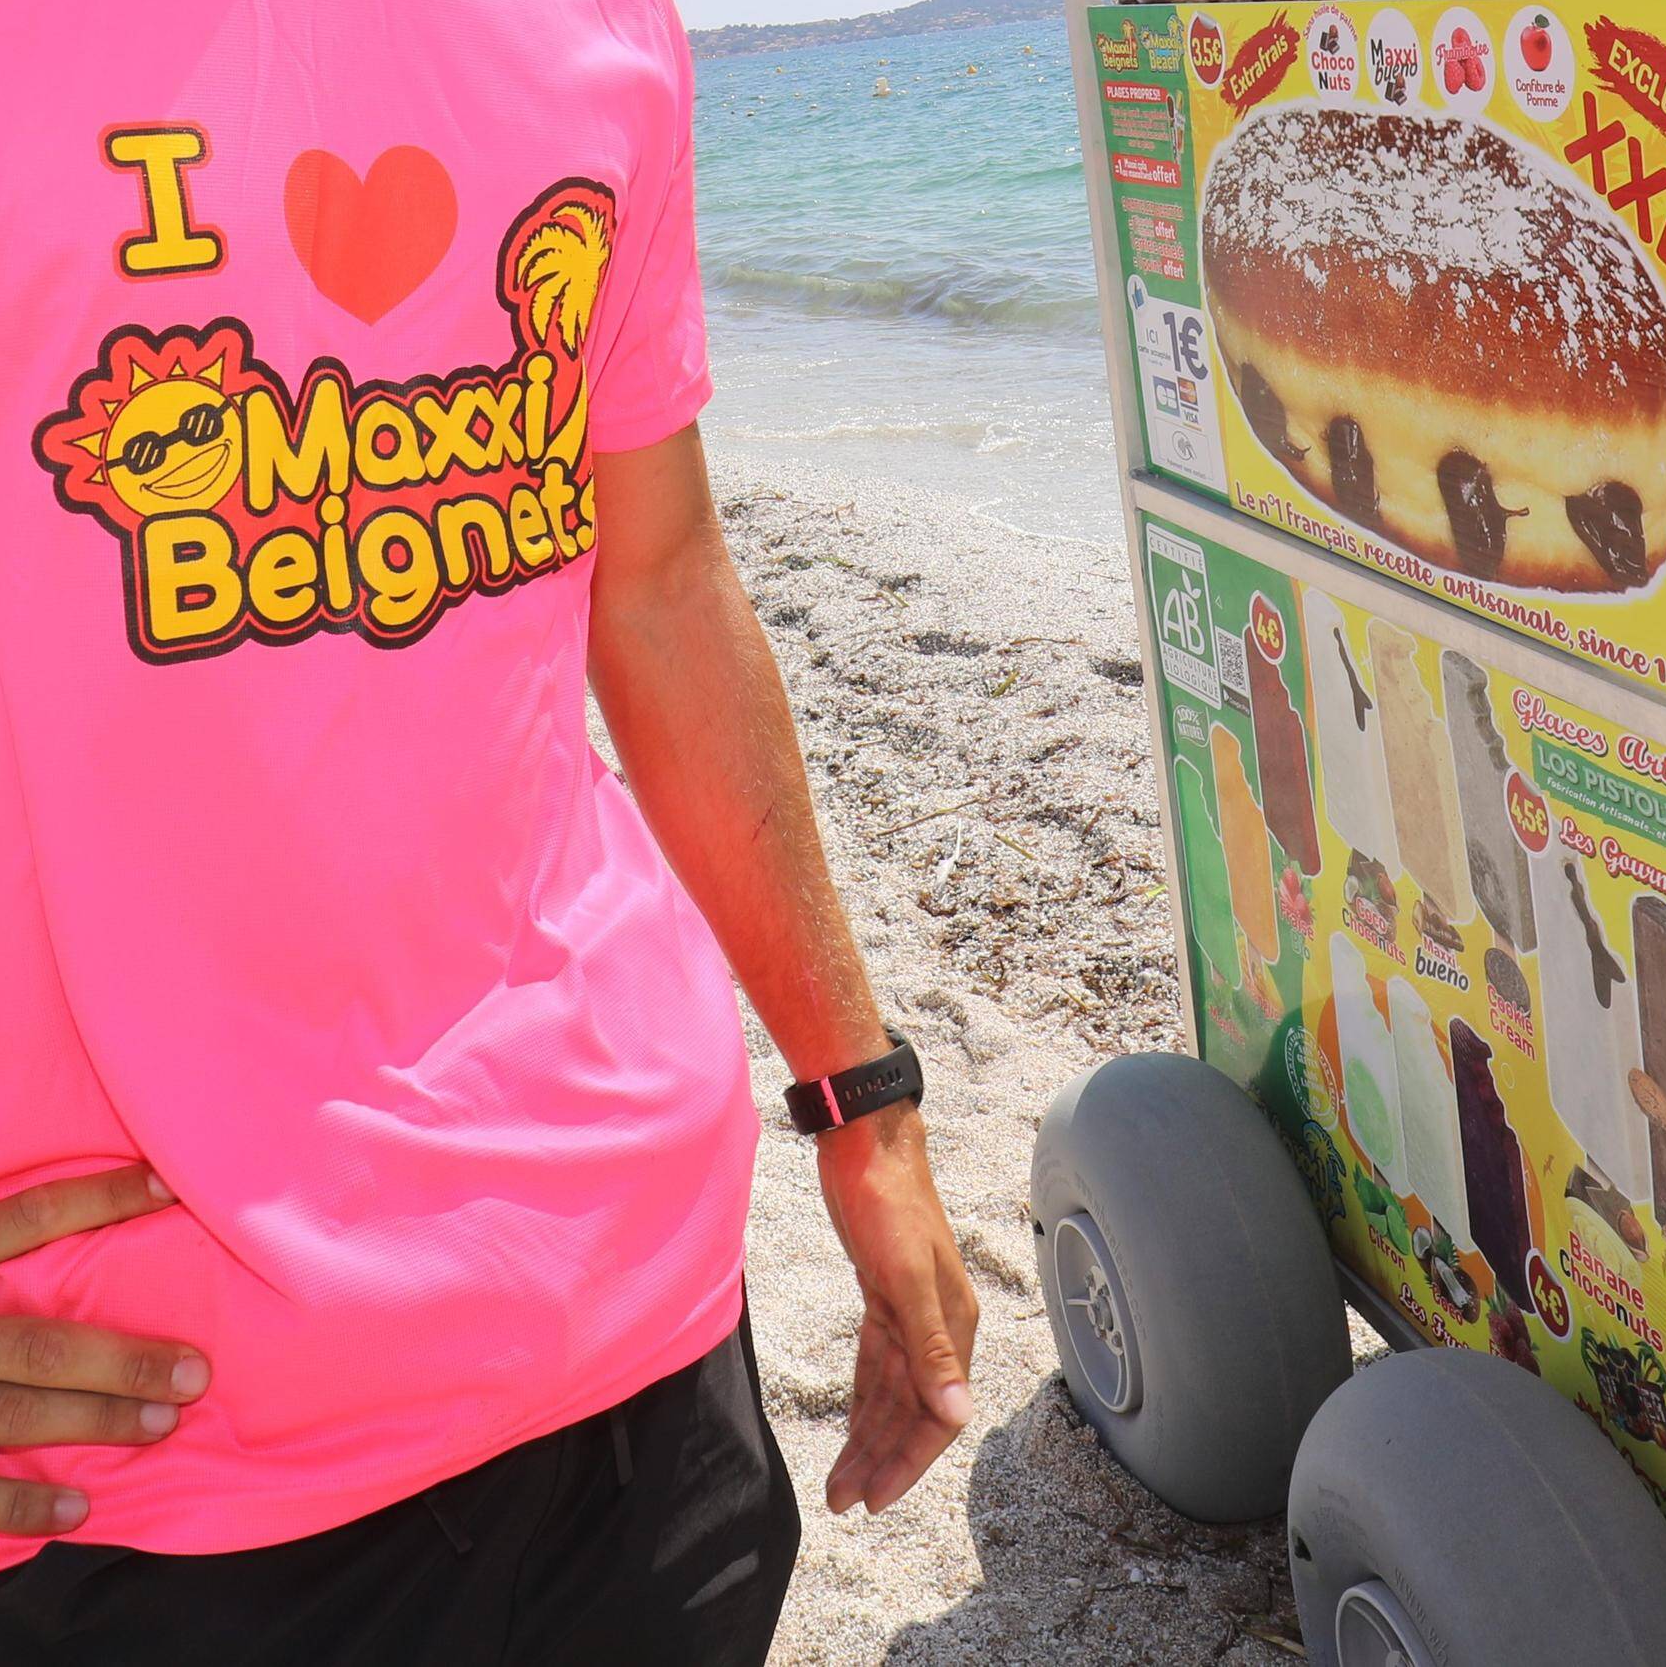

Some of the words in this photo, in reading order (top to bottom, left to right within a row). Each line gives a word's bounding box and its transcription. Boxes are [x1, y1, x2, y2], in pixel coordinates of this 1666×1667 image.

[1192, 38, 1222, 67] 3.5€
[1230, 32, 1289, 101] Extrafrais
[1311, 51, 1355, 70] Choco
[1371, 38, 1418, 66] Maxxi
[1375, 57, 1418, 86] bueno
[1435, 41, 1489, 67] Framboise
[1107, 86, 1130, 100] PLAGES
[1318, 72, 1351, 92] Nuts
[1516, 78, 1554, 94] Confiture
[1555, 80, 1566, 94] de
[1526, 92, 1559, 108] Pomme
[1153, 168, 1177, 184] offert
[106, 129, 223, 275] I
[1155, 221, 1176, 240] offert
[1163, 261, 1184, 279] offert
[1146, 328, 1159, 344] ICI
[1163, 312, 1208, 380] 1€
[245, 352, 555, 512] Maxxi
[1236, 481, 1256, 511] Le
[1363, 541, 1435, 587] recette
[1443, 572, 1575, 649] artisanale,
[1577, 628, 1652, 678] since
[1163, 587, 1206, 655] AB
[1257, 612, 1280, 649] 4€
[1163, 644, 1218, 684] AGRICULTURE
[1164, 659, 1220, 700] BIOLOGIQUE
[1511, 687, 1608, 755] Glaces
[1537, 744, 1580, 784] LOS
[1547, 776, 1597, 810] Fabrication
[1559, 815, 1596, 857] Les
[1355, 898, 1388, 935] Coco
[1341, 908, 1407, 967] Choconuts
[1423, 934, 1457, 967] Maxxi
[1415, 945, 1469, 992] bueno
[1487, 983, 1534, 1037] Cookie
[1489, 1009, 1536, 1062] Cream
[1369, 1225, 1406, 1272] Citron
[1568, 1230, 1645, 1313] Banane
[1399, 1282, 1427, 1326] Les
[1533, 1275, 1565, 1327] 4€
[1559, 1249, 1664, 1354] Choconuts
